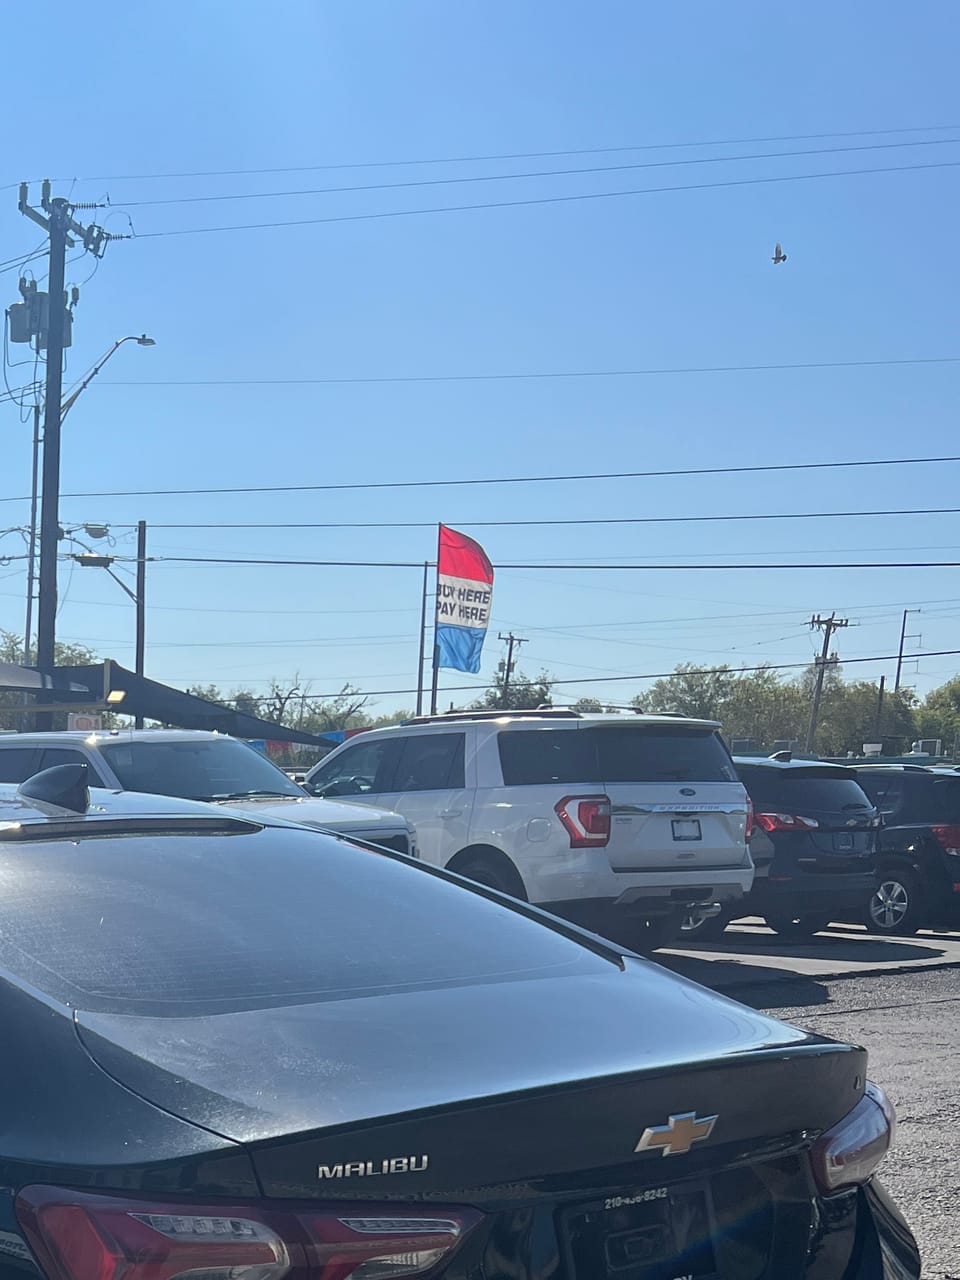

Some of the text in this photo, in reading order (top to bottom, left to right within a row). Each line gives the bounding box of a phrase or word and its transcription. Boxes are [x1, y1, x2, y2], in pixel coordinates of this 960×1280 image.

[458, 588, 490, 604] HERE
[436, 602, 487, 621] PAY HERE
[318, 1154, 429, 1179] MALIBU
